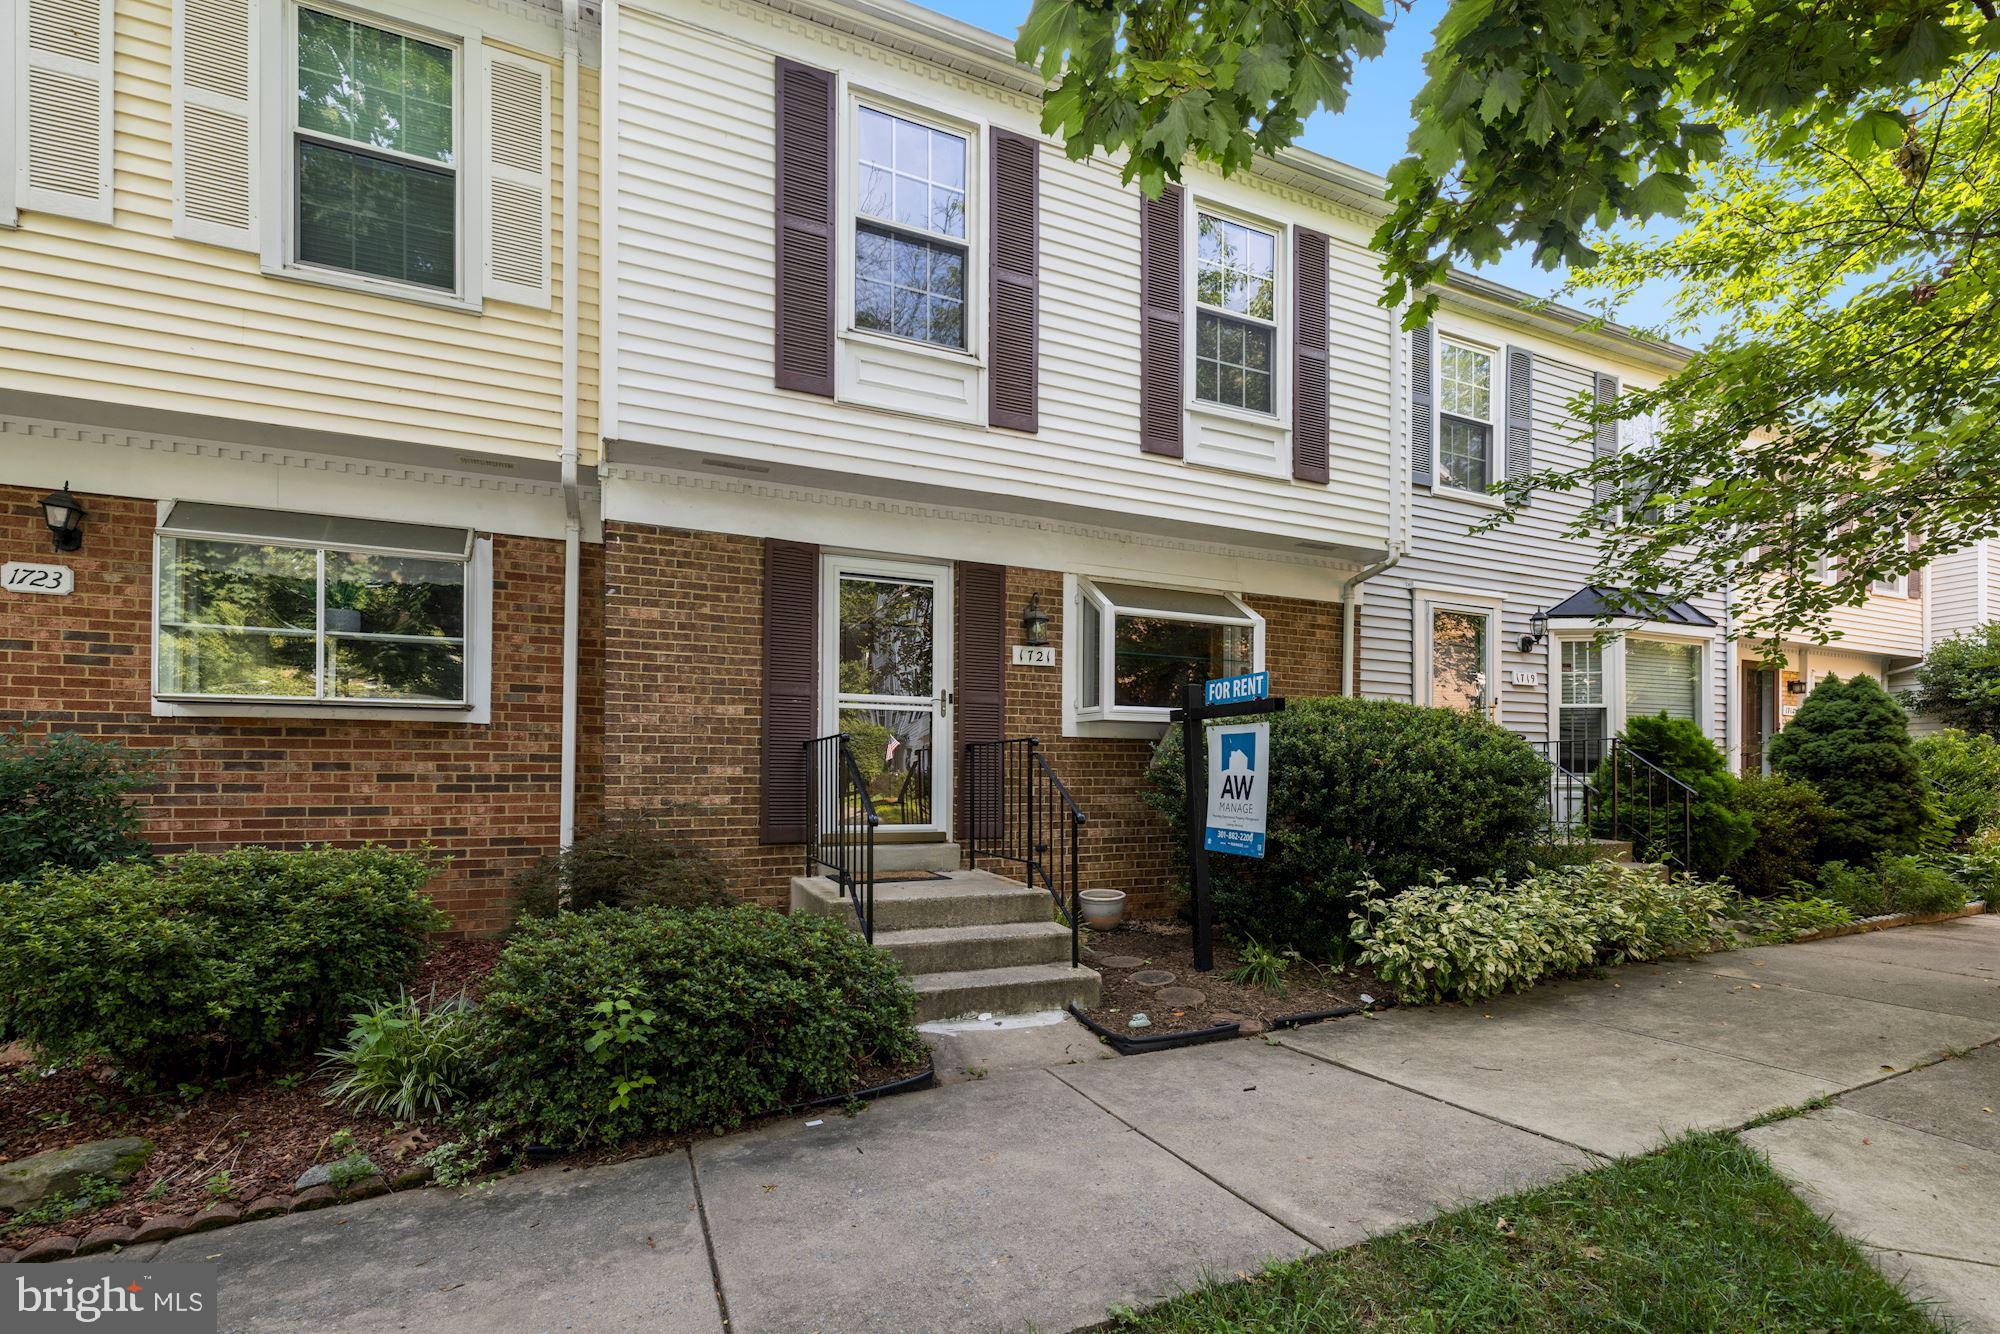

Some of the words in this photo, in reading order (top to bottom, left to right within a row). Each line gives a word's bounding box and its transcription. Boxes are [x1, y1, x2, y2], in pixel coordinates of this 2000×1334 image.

[8, 568, 63, 589] 1723
[1019, 649, 1051, 663] 1721
[1516, 672, 1536, 684] 1719
[1209, 681, 1231, 701] FOR
[1233, 675, 1264, 698] RENT
[1220, 774, 1255, 801] AW
[1218, 801, 1254, 815] MANAGE
